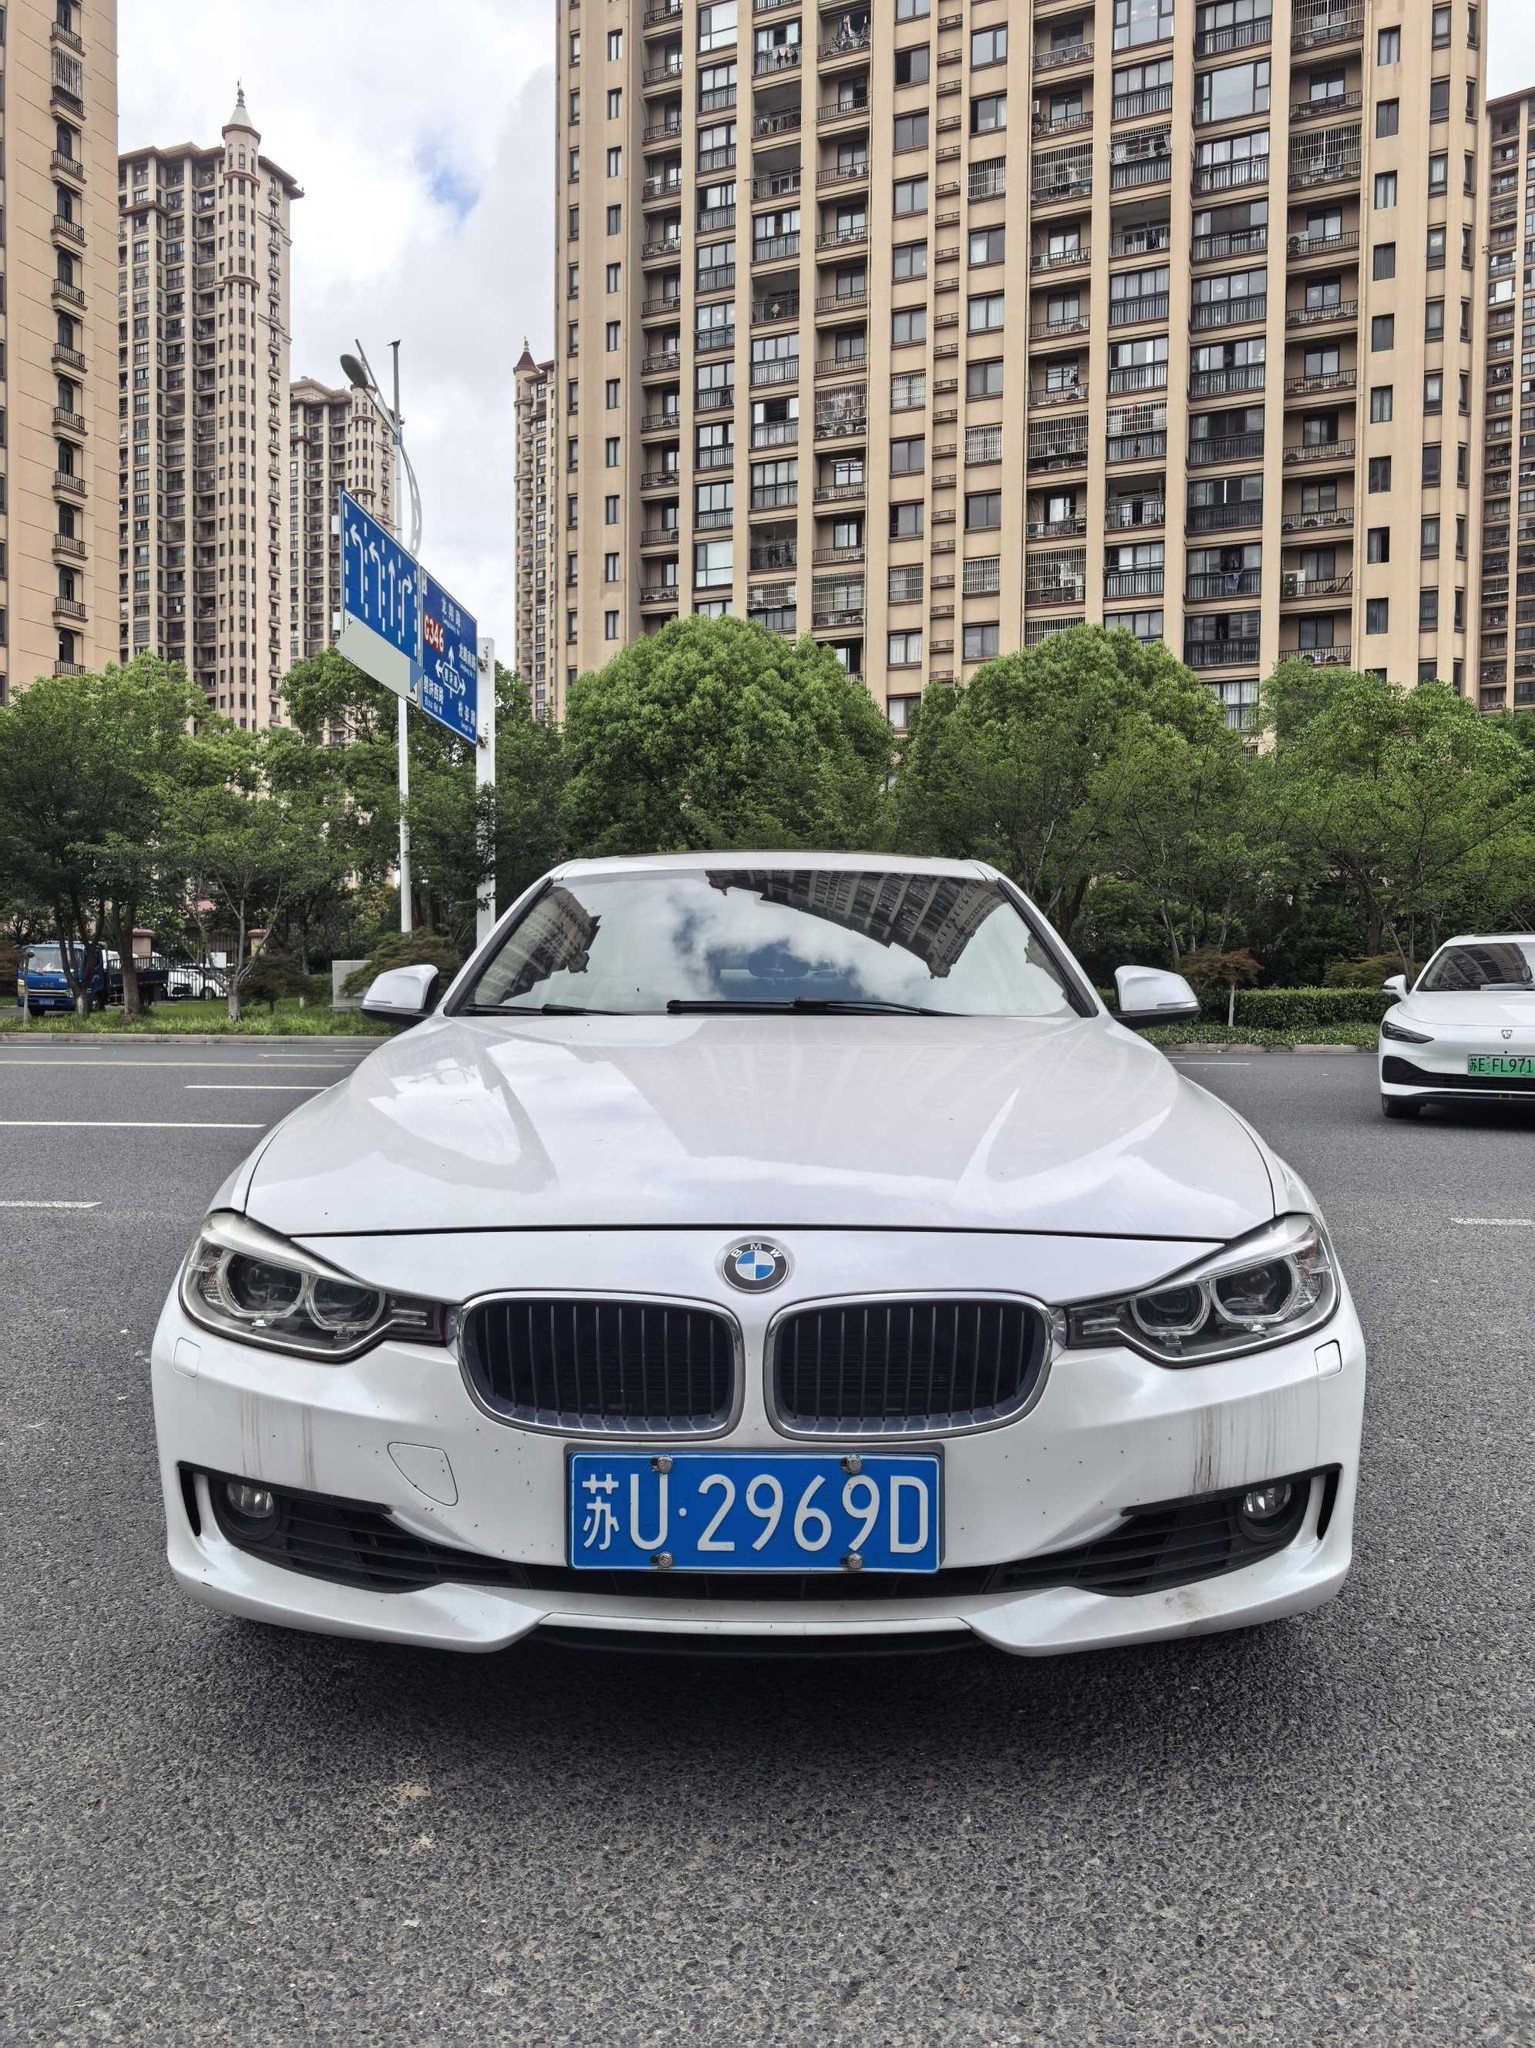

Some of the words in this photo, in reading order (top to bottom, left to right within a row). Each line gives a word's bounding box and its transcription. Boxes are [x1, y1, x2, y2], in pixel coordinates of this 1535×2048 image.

[423, 615, 444, 653] G346
[731, 1243, 782, 1258] BMW
[582, 1474, 928, 1553] 苏U·2969D
